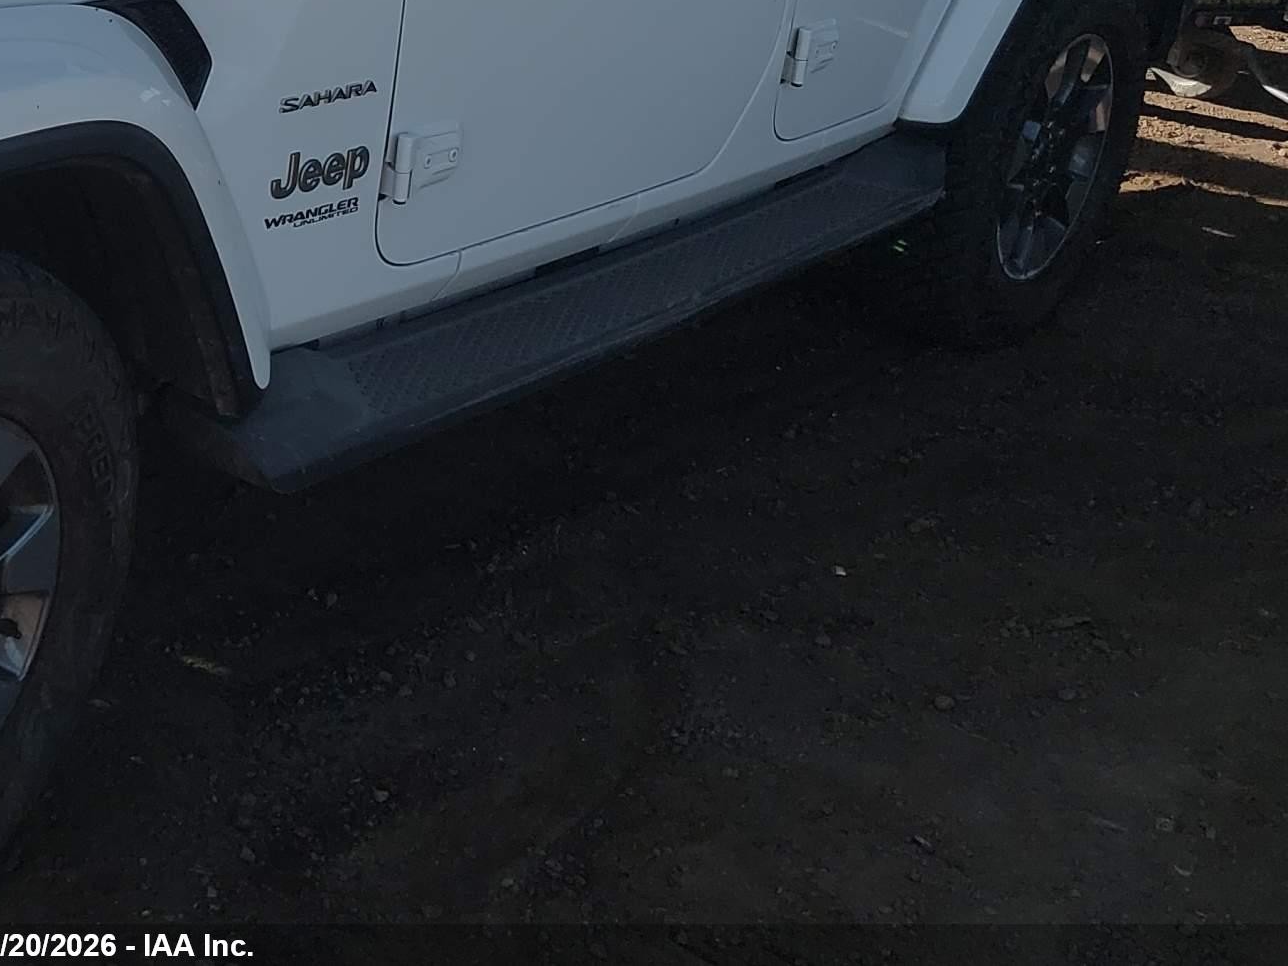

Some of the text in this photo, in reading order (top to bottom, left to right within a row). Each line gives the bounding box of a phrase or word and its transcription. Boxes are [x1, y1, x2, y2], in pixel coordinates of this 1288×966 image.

[279, 80, 378, 114] SAHARA
[270, 145, 370, 200] Jeep
[264, 197, 359, 229] WRANGLER
[293, 207, 359, 228] UNLIMITED
